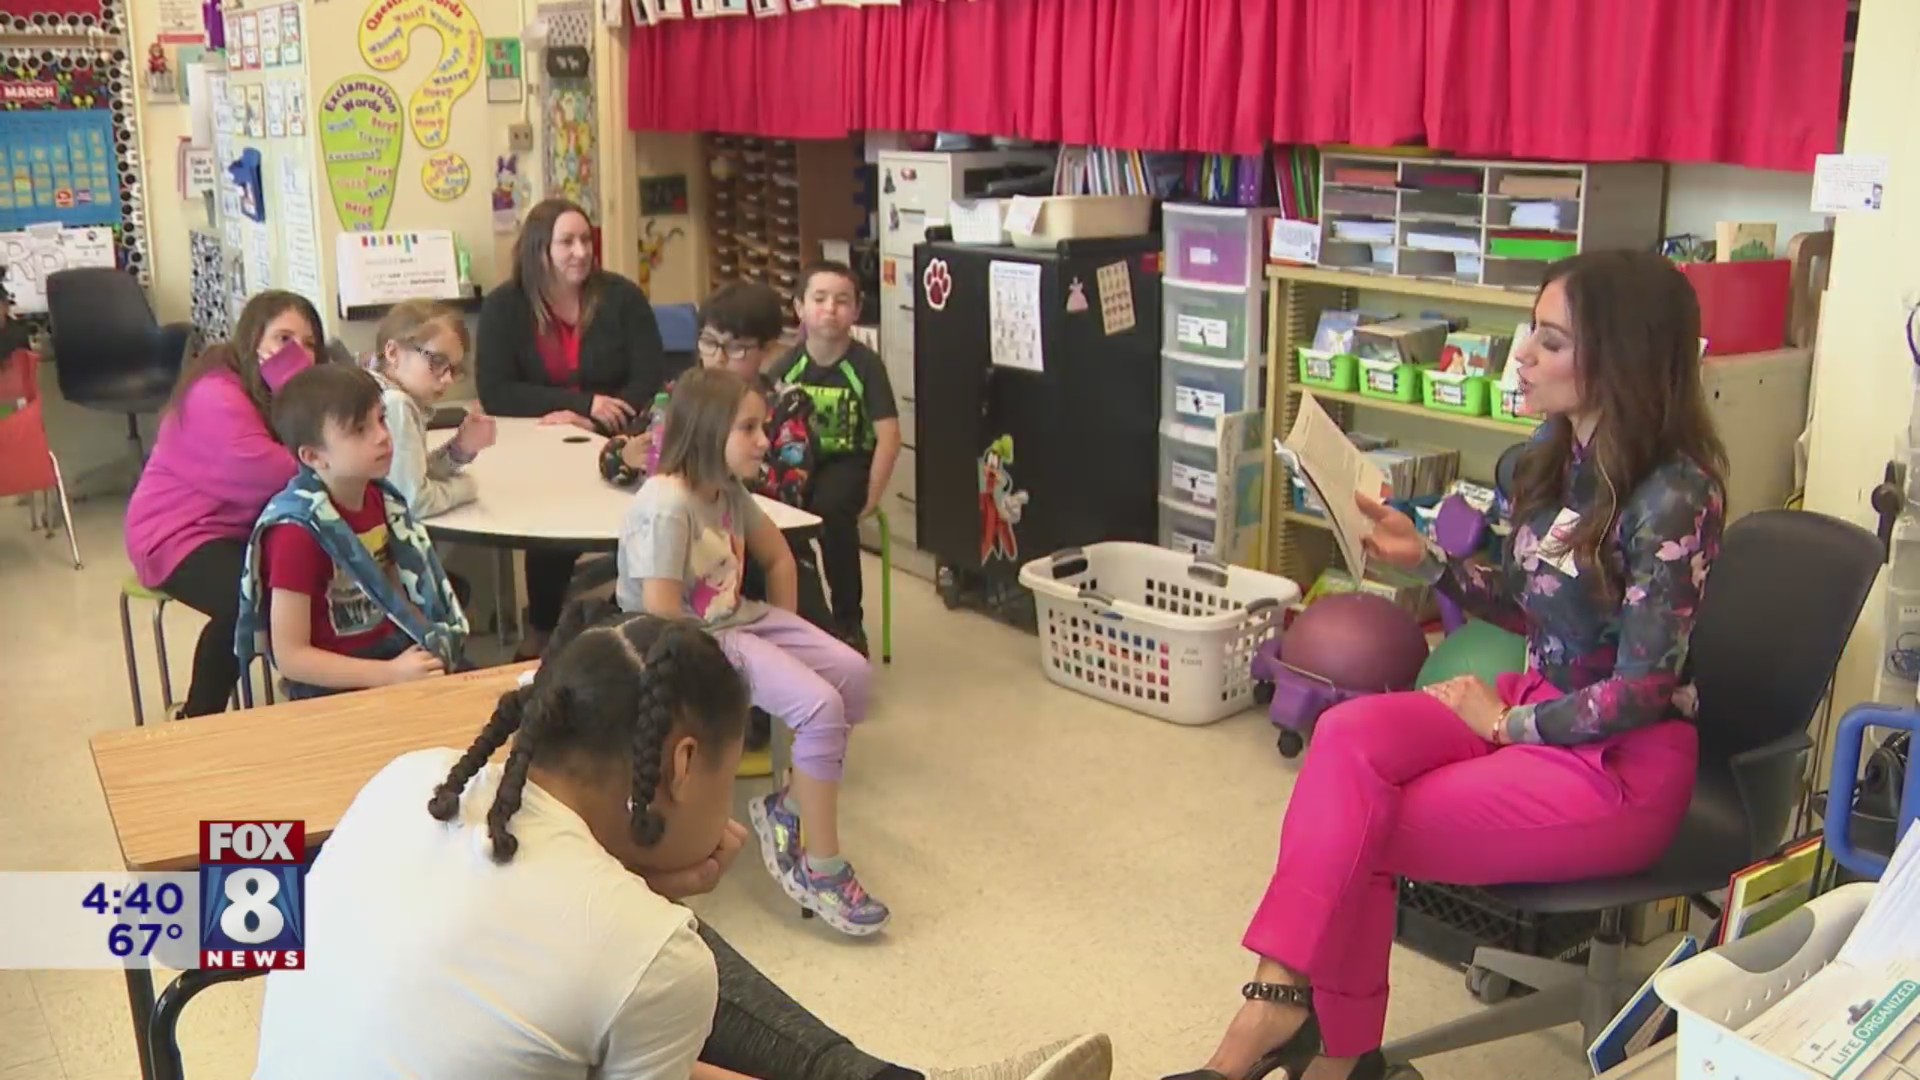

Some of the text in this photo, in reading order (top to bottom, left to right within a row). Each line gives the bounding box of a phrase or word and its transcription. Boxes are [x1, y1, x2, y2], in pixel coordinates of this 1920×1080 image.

[4, 85, 54, 98] MARCH
[325, 82, 396, 114] Exclamation
[342, 99, 382, 113] Words
[1831, 982, 1916, 1064] LIFE ORGANIZED
